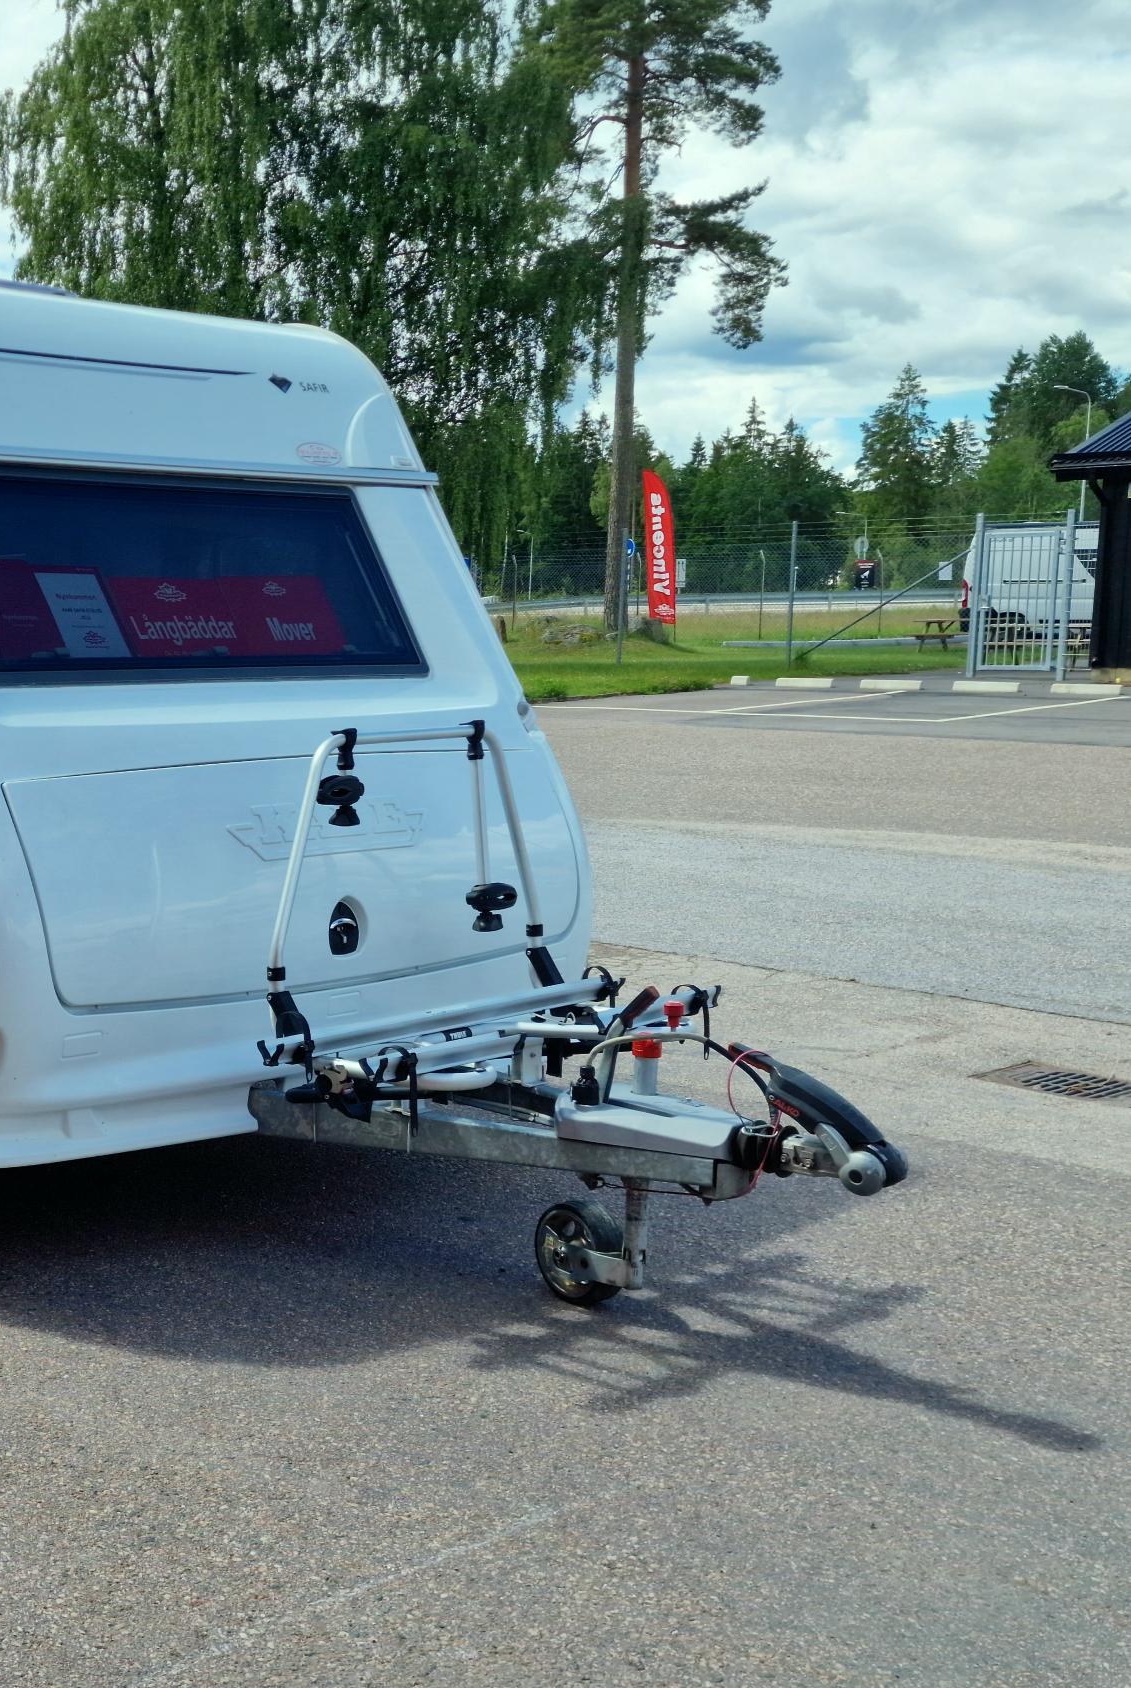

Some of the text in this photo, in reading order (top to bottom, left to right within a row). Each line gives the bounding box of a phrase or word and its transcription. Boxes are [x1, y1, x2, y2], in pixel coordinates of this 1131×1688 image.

[299, 381, 330, 394] SAFIR
[129, 613, 237, 646] Långbäddar
[265, 616, 316, 642] Mover
[450, 1030, 467, 1041] THULE
